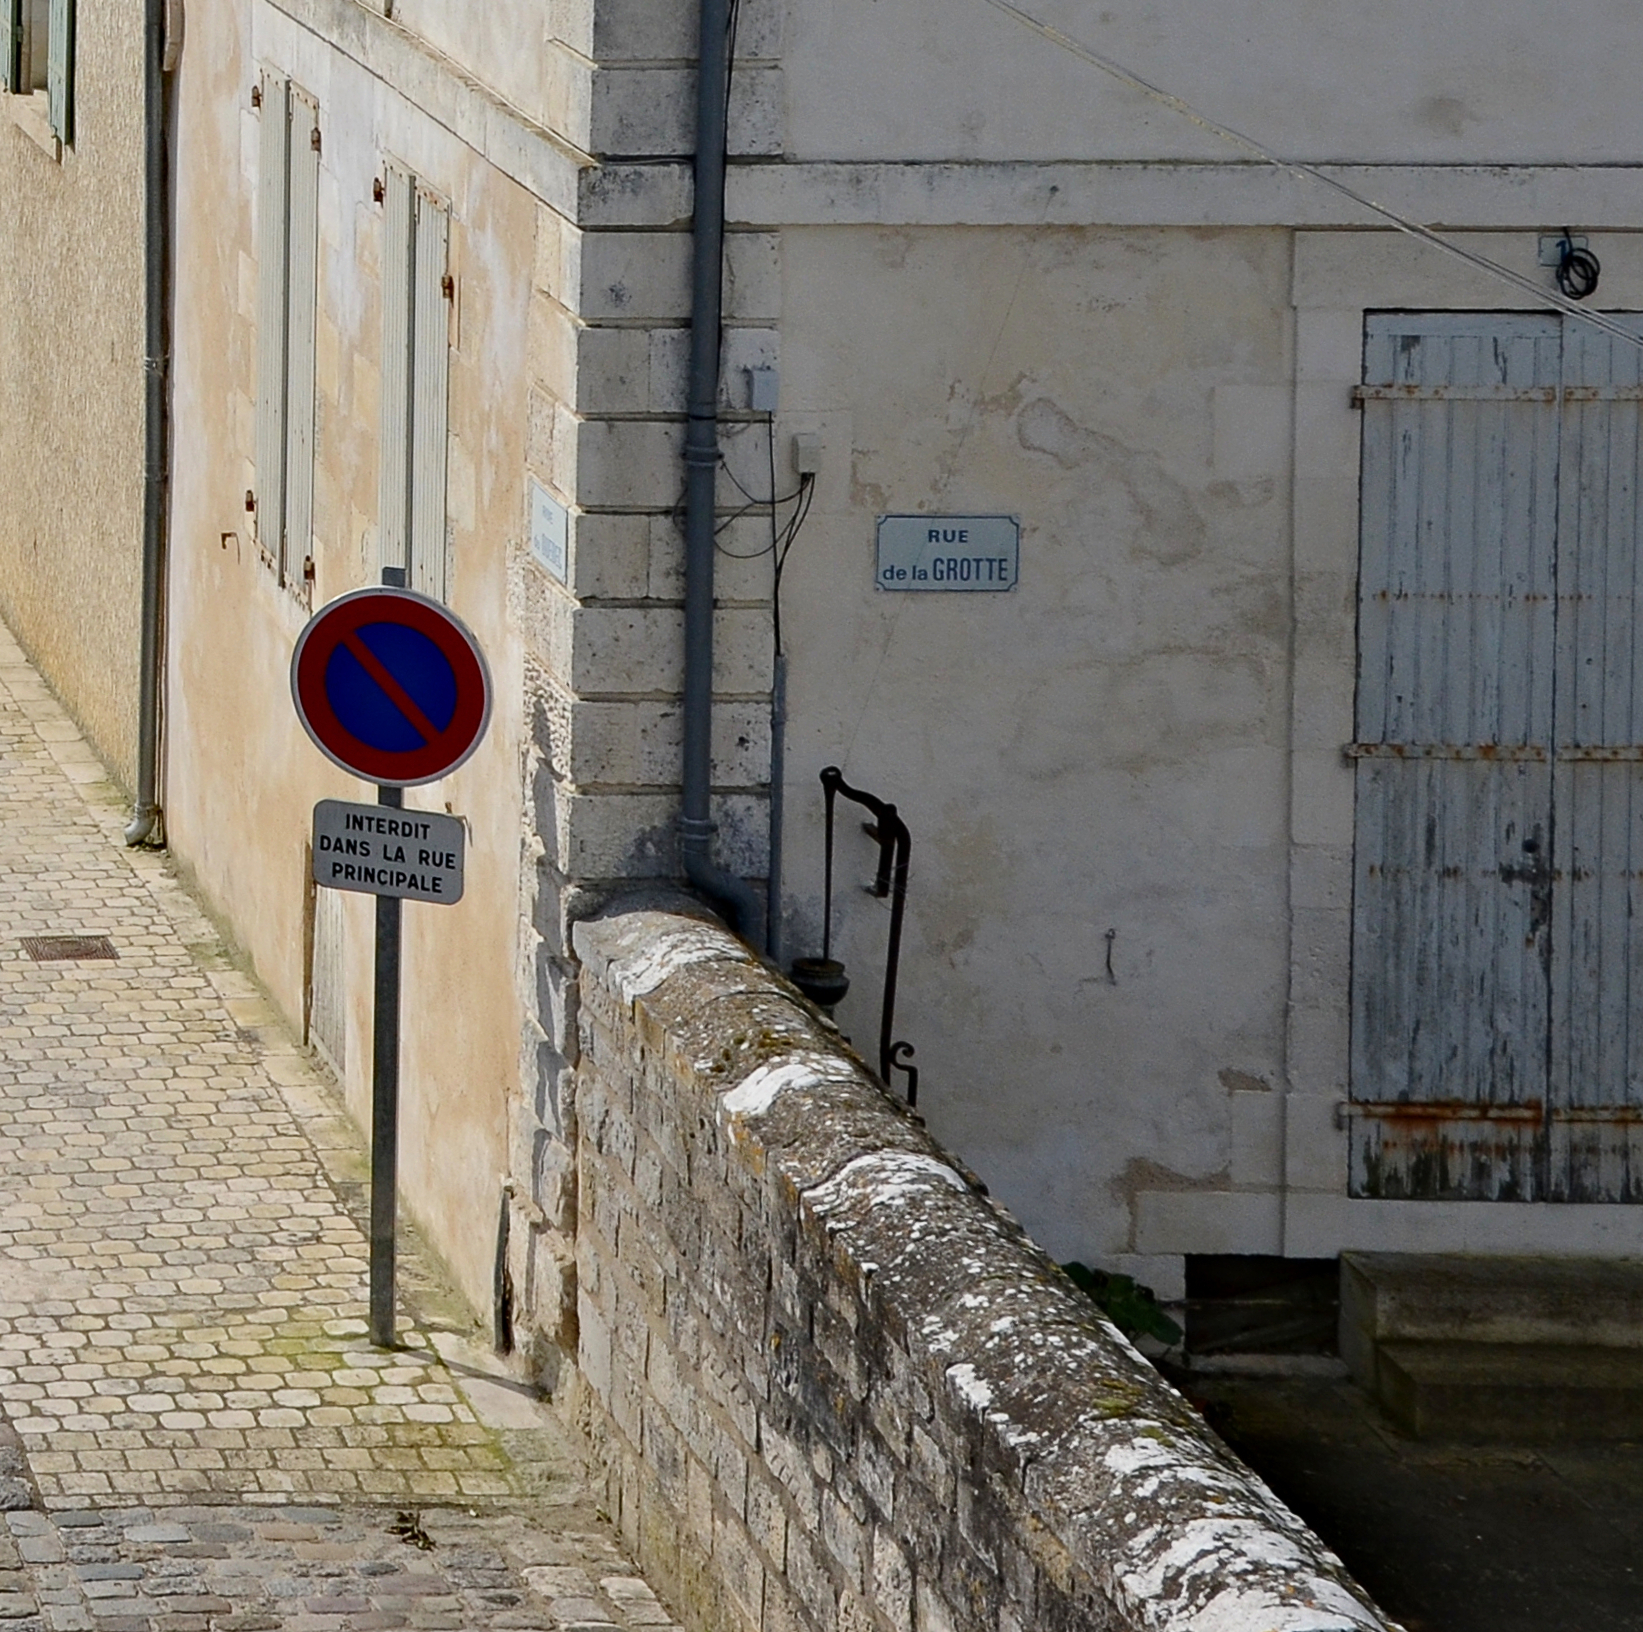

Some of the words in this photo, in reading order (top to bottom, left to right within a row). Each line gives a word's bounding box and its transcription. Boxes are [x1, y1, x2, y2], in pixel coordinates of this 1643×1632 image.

[928, 529, 969, 543] RUE
[883, 565, 907, 581] de
[912, 565, 928, 581] la
[932, 558, 1008, 581] GROTTE
[346, 813, 431, 840] INTERDIT
[319, 835, 371, 857] DANS
[383, 845, 405, 863] LA
[418, 849, 456, 869] RUE
[331, 862, 443, 893] PRINCIPALE
